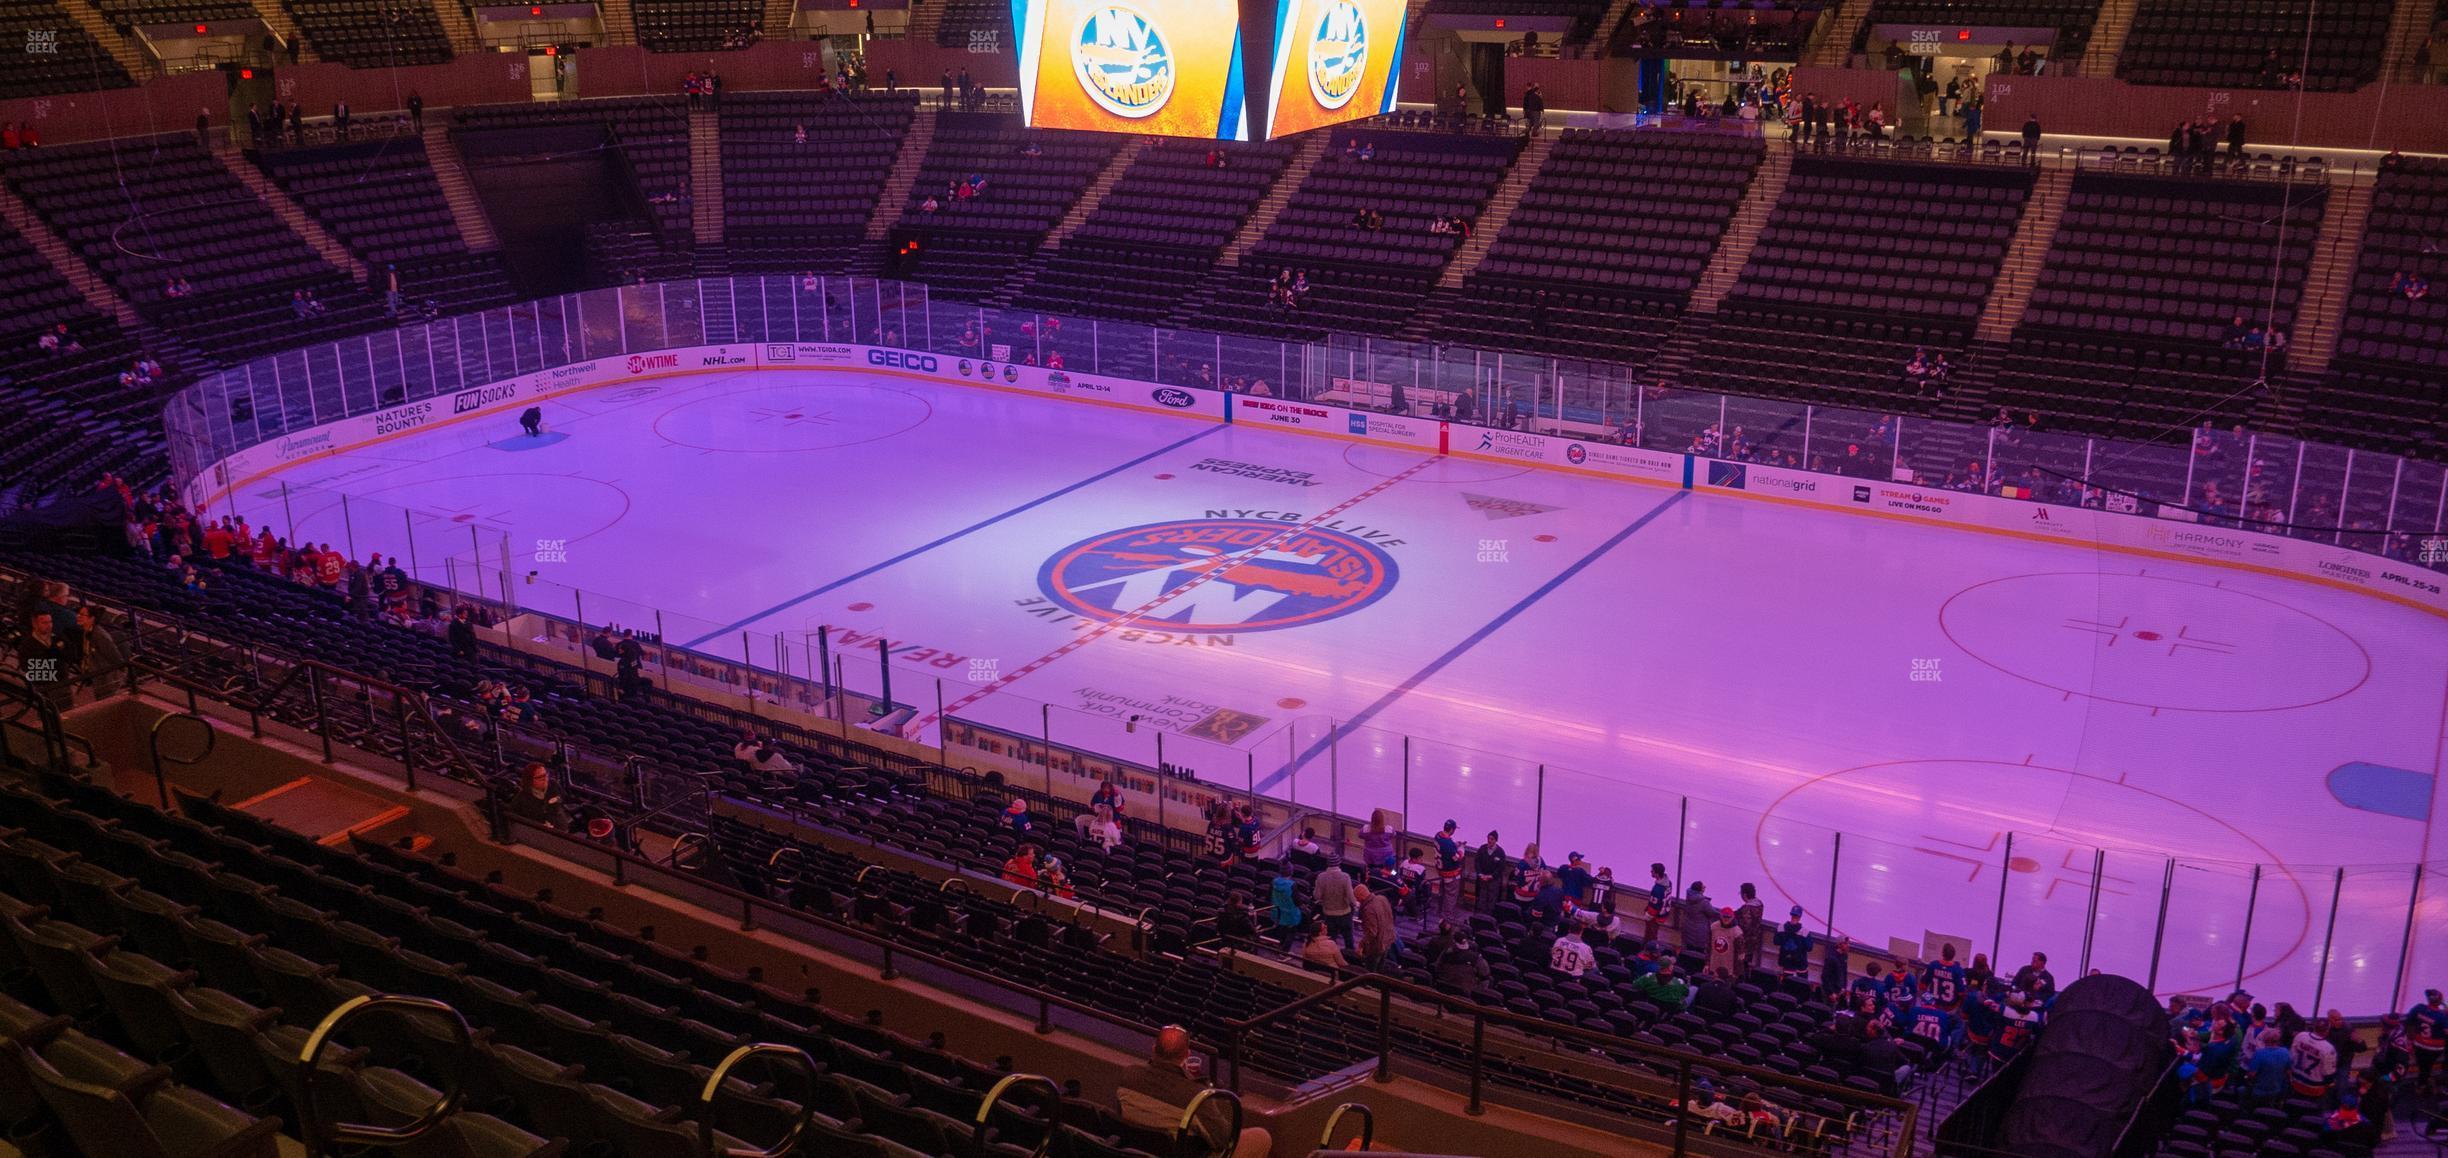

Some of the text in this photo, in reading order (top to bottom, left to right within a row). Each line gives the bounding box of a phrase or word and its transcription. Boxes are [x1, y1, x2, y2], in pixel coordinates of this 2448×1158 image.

[1415, 62, 1429, 72] 102
[1991, 84, 2011, 94] 104
[2210, 92, 2230, 102] 105
[627, 354, 678, 374] SHOWTIME
[703, 356, 745, 366] NHL.COM
[868, 349, 937, 373] GEICO
[552, 362, 596, 379] Northwell
[1078, 382, 1095, 391] APRIL
[456, 383, 516, 411] FUN SOCKS
[1158, 389, 1188, 407] Ford
[375, 402, 432, 425] NATURE'S
[1277, 404, 1288, 413] ON
[1289, 406, 1302, 415] THE
[377, 415, 427, 435] BOUNTY
[1270, 414, 1300, 424] JUNE 30
[1350, 420, 1365, 428] HSS
[1369, 420, 1406, 431] HOSPITAL FOR
[1369, 426, 1416, 438] SPECIAL SURGERY
[1495, 432, 1545, 447] ProHEALTH
[276, 432, 333, 460] Paramount
[1495, 445, 1544, 459] URGENT CARE
[1189, 463, 1323, 487] AMERICAN
[1204, 458, 1315, 479] EXPRESS
[1753, 474, 1816, 492] nationalgrid
[1880, 489, 1911, 499] STREAM
[1923, 495, 1949, 505] GAMES
[1915, 504, 1931, 512] MSG
[1205, 509, 1407, 548] NYCB LIVE
[2175, 532, 2244, 548] HARMONY
[1130, 528, 1369, 589] ISLANDERS
[325, 561, 340, 575] 29
[2319, 561, 2370, 578] LONGINES
[2381, 572, 2440, 594] APRIL 25-28
[1014, 597, 1234, 647] NYCB LIVE
[1073, 687, 1200, 724] Community
[1161, 695, 1220, 714] Bank
[1079, 701, 1189, 732] New York
[1552, 948, 1577, 971] 39
[1933, 978, 1954, 1002] 13
[1912, 1022, 1940, 1042] 40
[2294, 1050, 2321, 1075] 17
